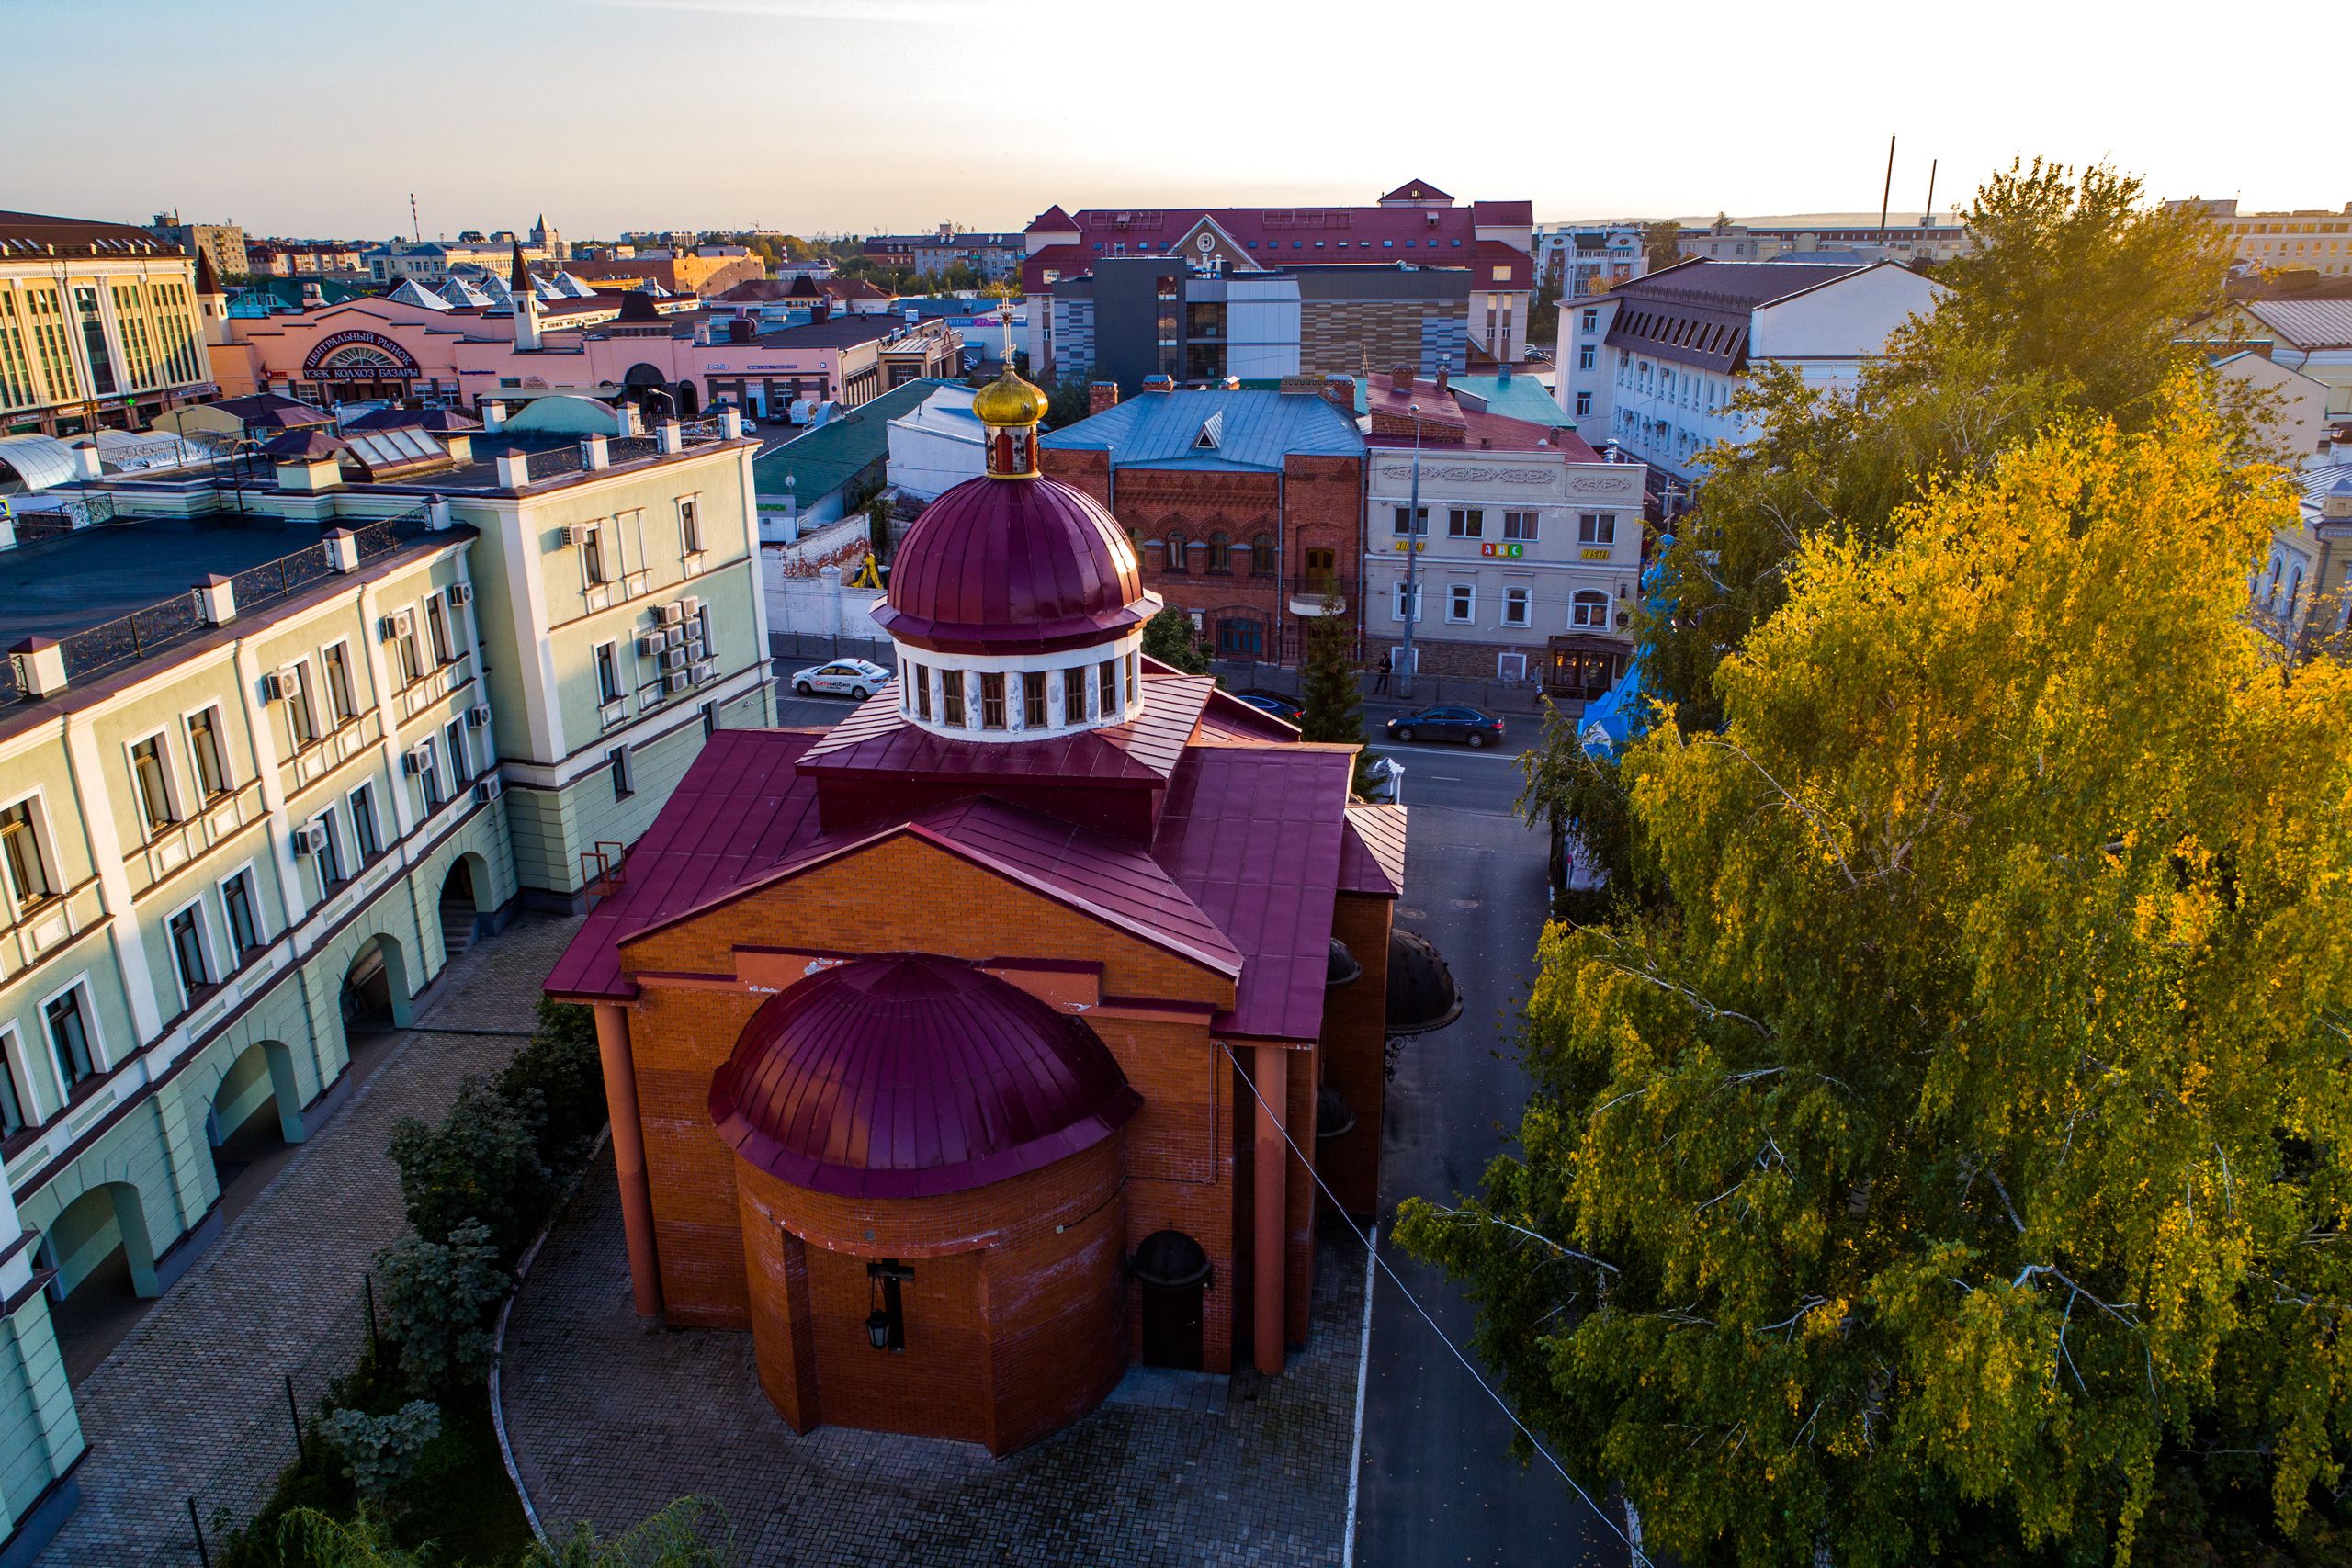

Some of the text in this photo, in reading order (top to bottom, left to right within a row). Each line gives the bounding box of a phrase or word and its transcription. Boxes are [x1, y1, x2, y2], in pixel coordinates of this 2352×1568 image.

[307, 332, 413, 367] ЦЕНТРАЛЬНЫЙ РЫНОК
[334, 368, 375, 378] КОЛХОЗ
[379, 368, 419, 378] БАЗАРЫ
[1484, 544, 1520, 556] ABC
[1581, 549, 1610, 559] HOSTEL
